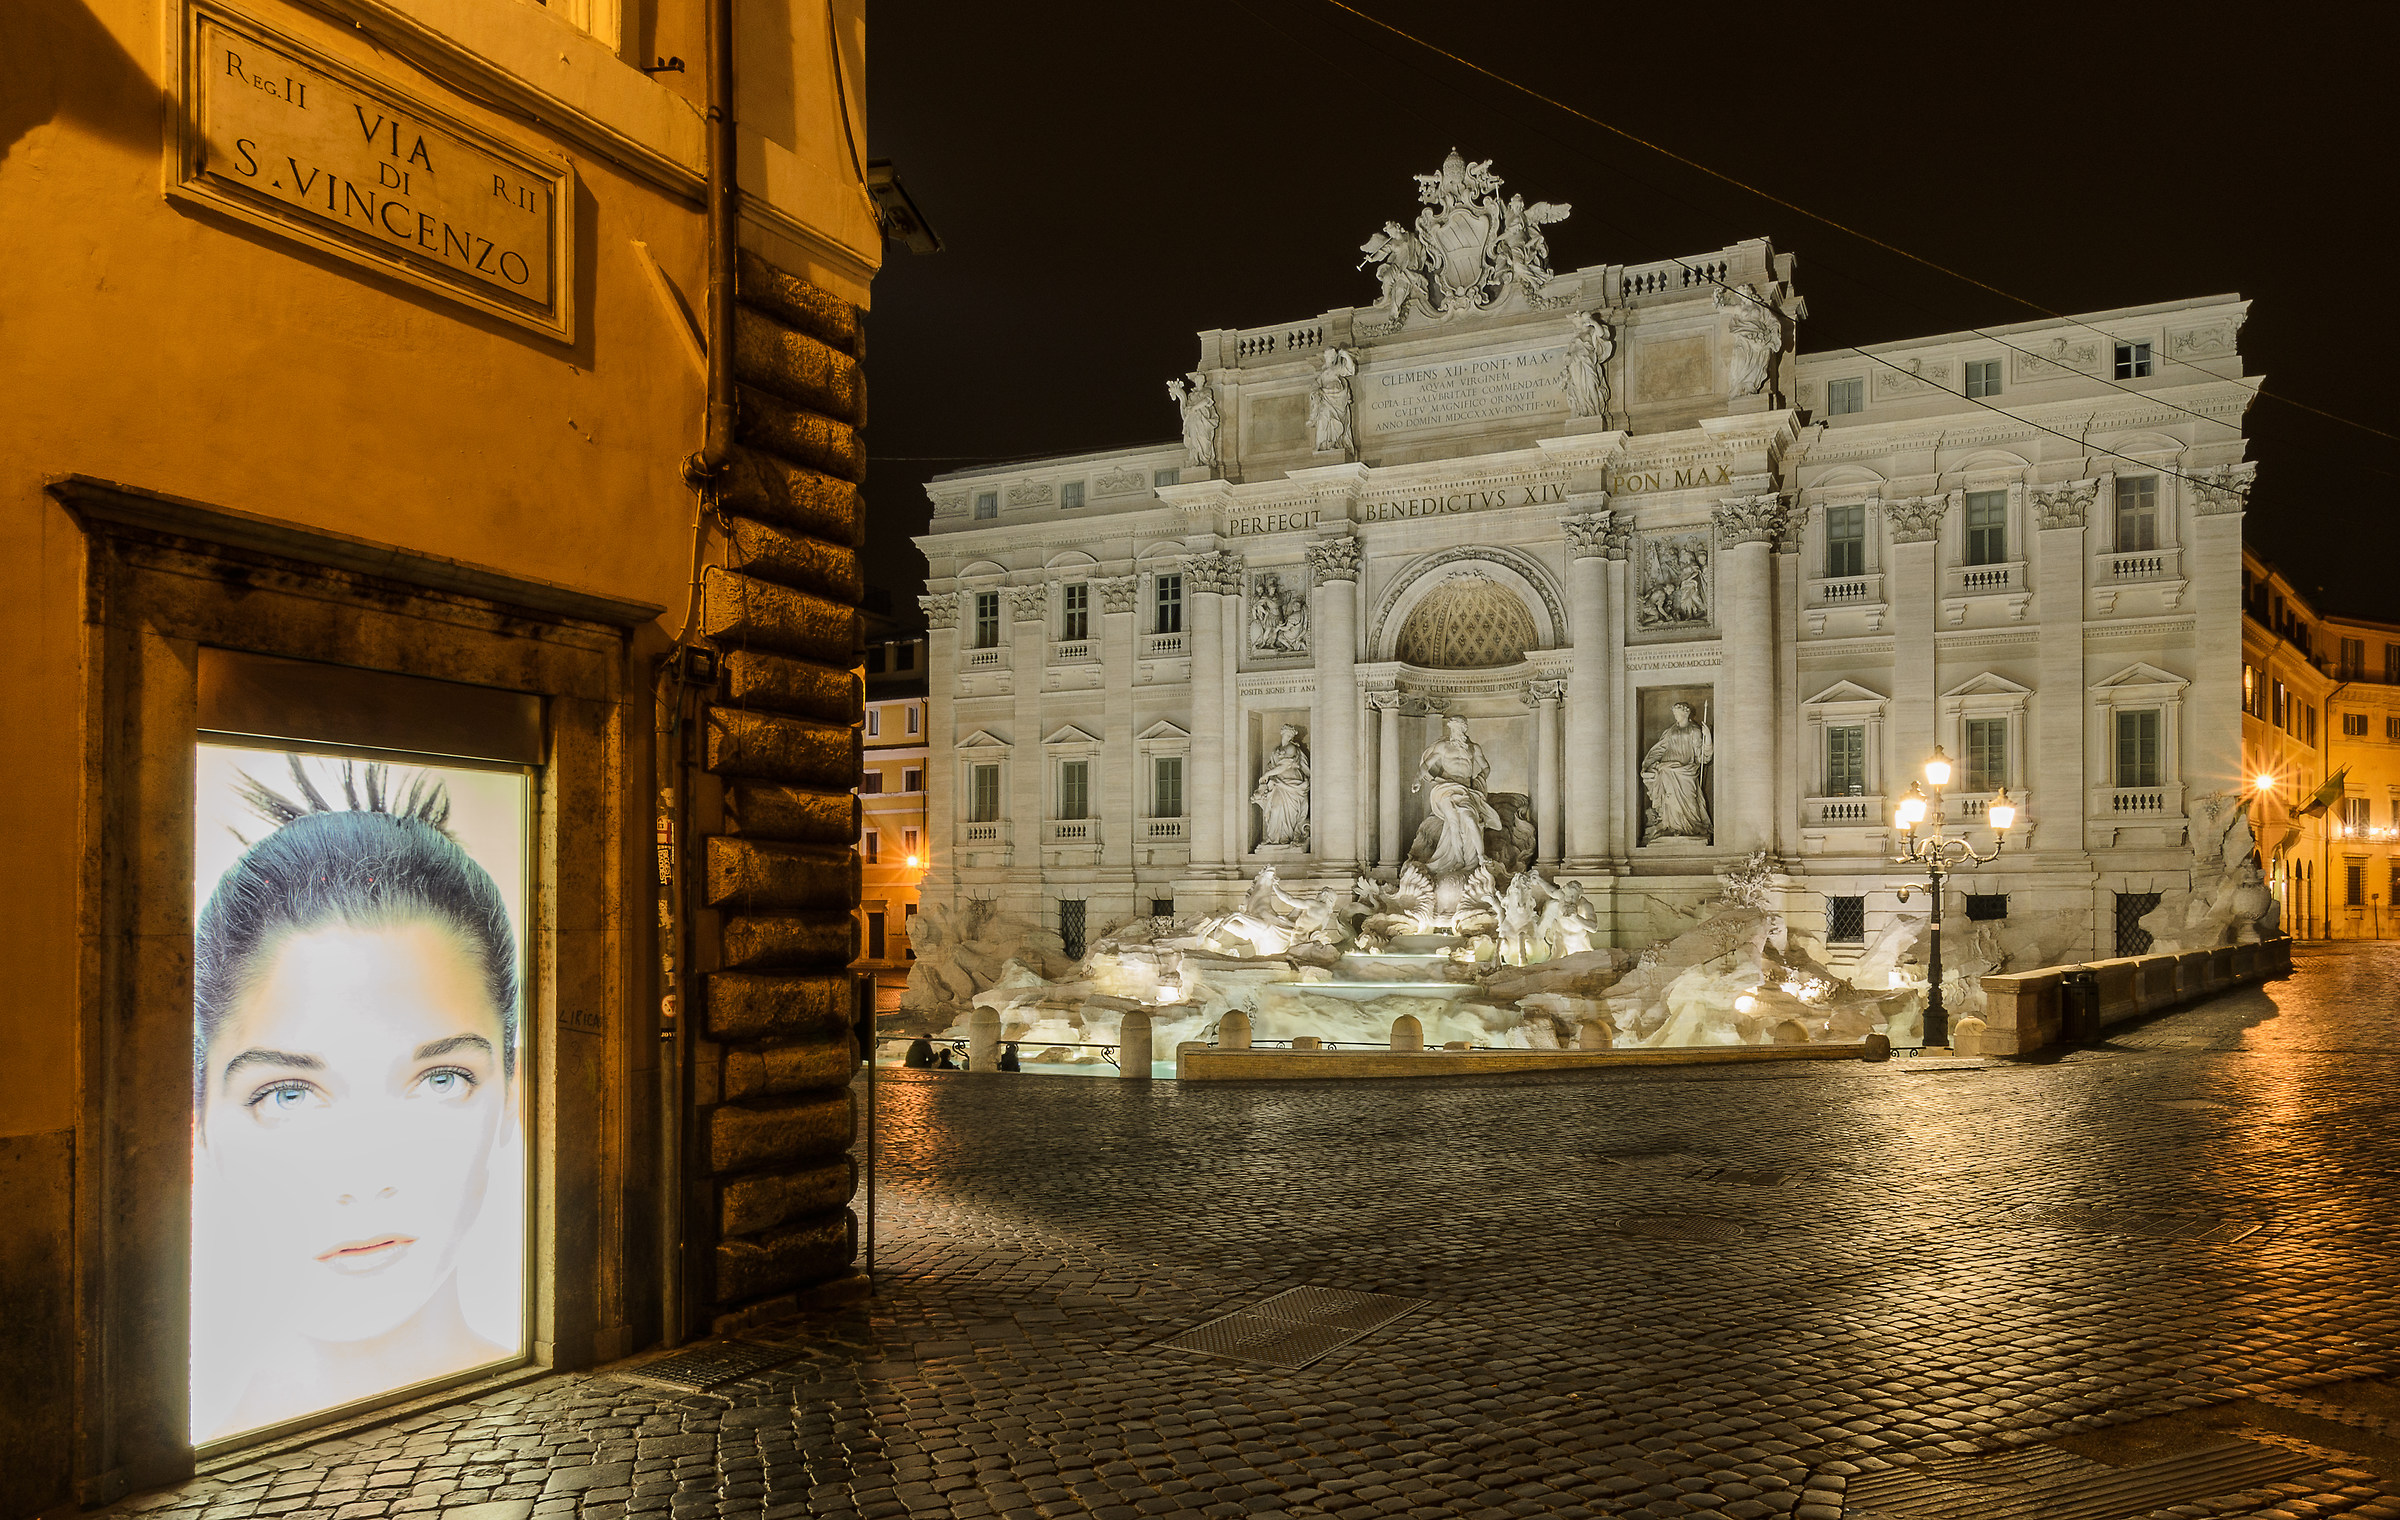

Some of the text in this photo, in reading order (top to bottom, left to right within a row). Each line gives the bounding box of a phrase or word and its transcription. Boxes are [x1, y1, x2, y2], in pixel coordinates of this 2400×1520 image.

[354, 104, 434, 173] VIA
[379, 161, 410, 196] DI
[1371, 399, 1399, 410] COPIA
[1403, 396, 1414, 406] ET
[1482, 376, 1560, 395] COMMENDATAM
[1382, 369, 1438, 387] CLEMENS
[1420, 372, 1510, 392] AQVAM VIRGINEM
[1394, 391, 1536, 418] CVLTV MAGNIFICO ORNAVIT
[1376, 420, 1403, 431] ANNO
[1406, 415, 1441, 427] DOMINI
[1366, 489, 1506, 522] BENEDICTVS
